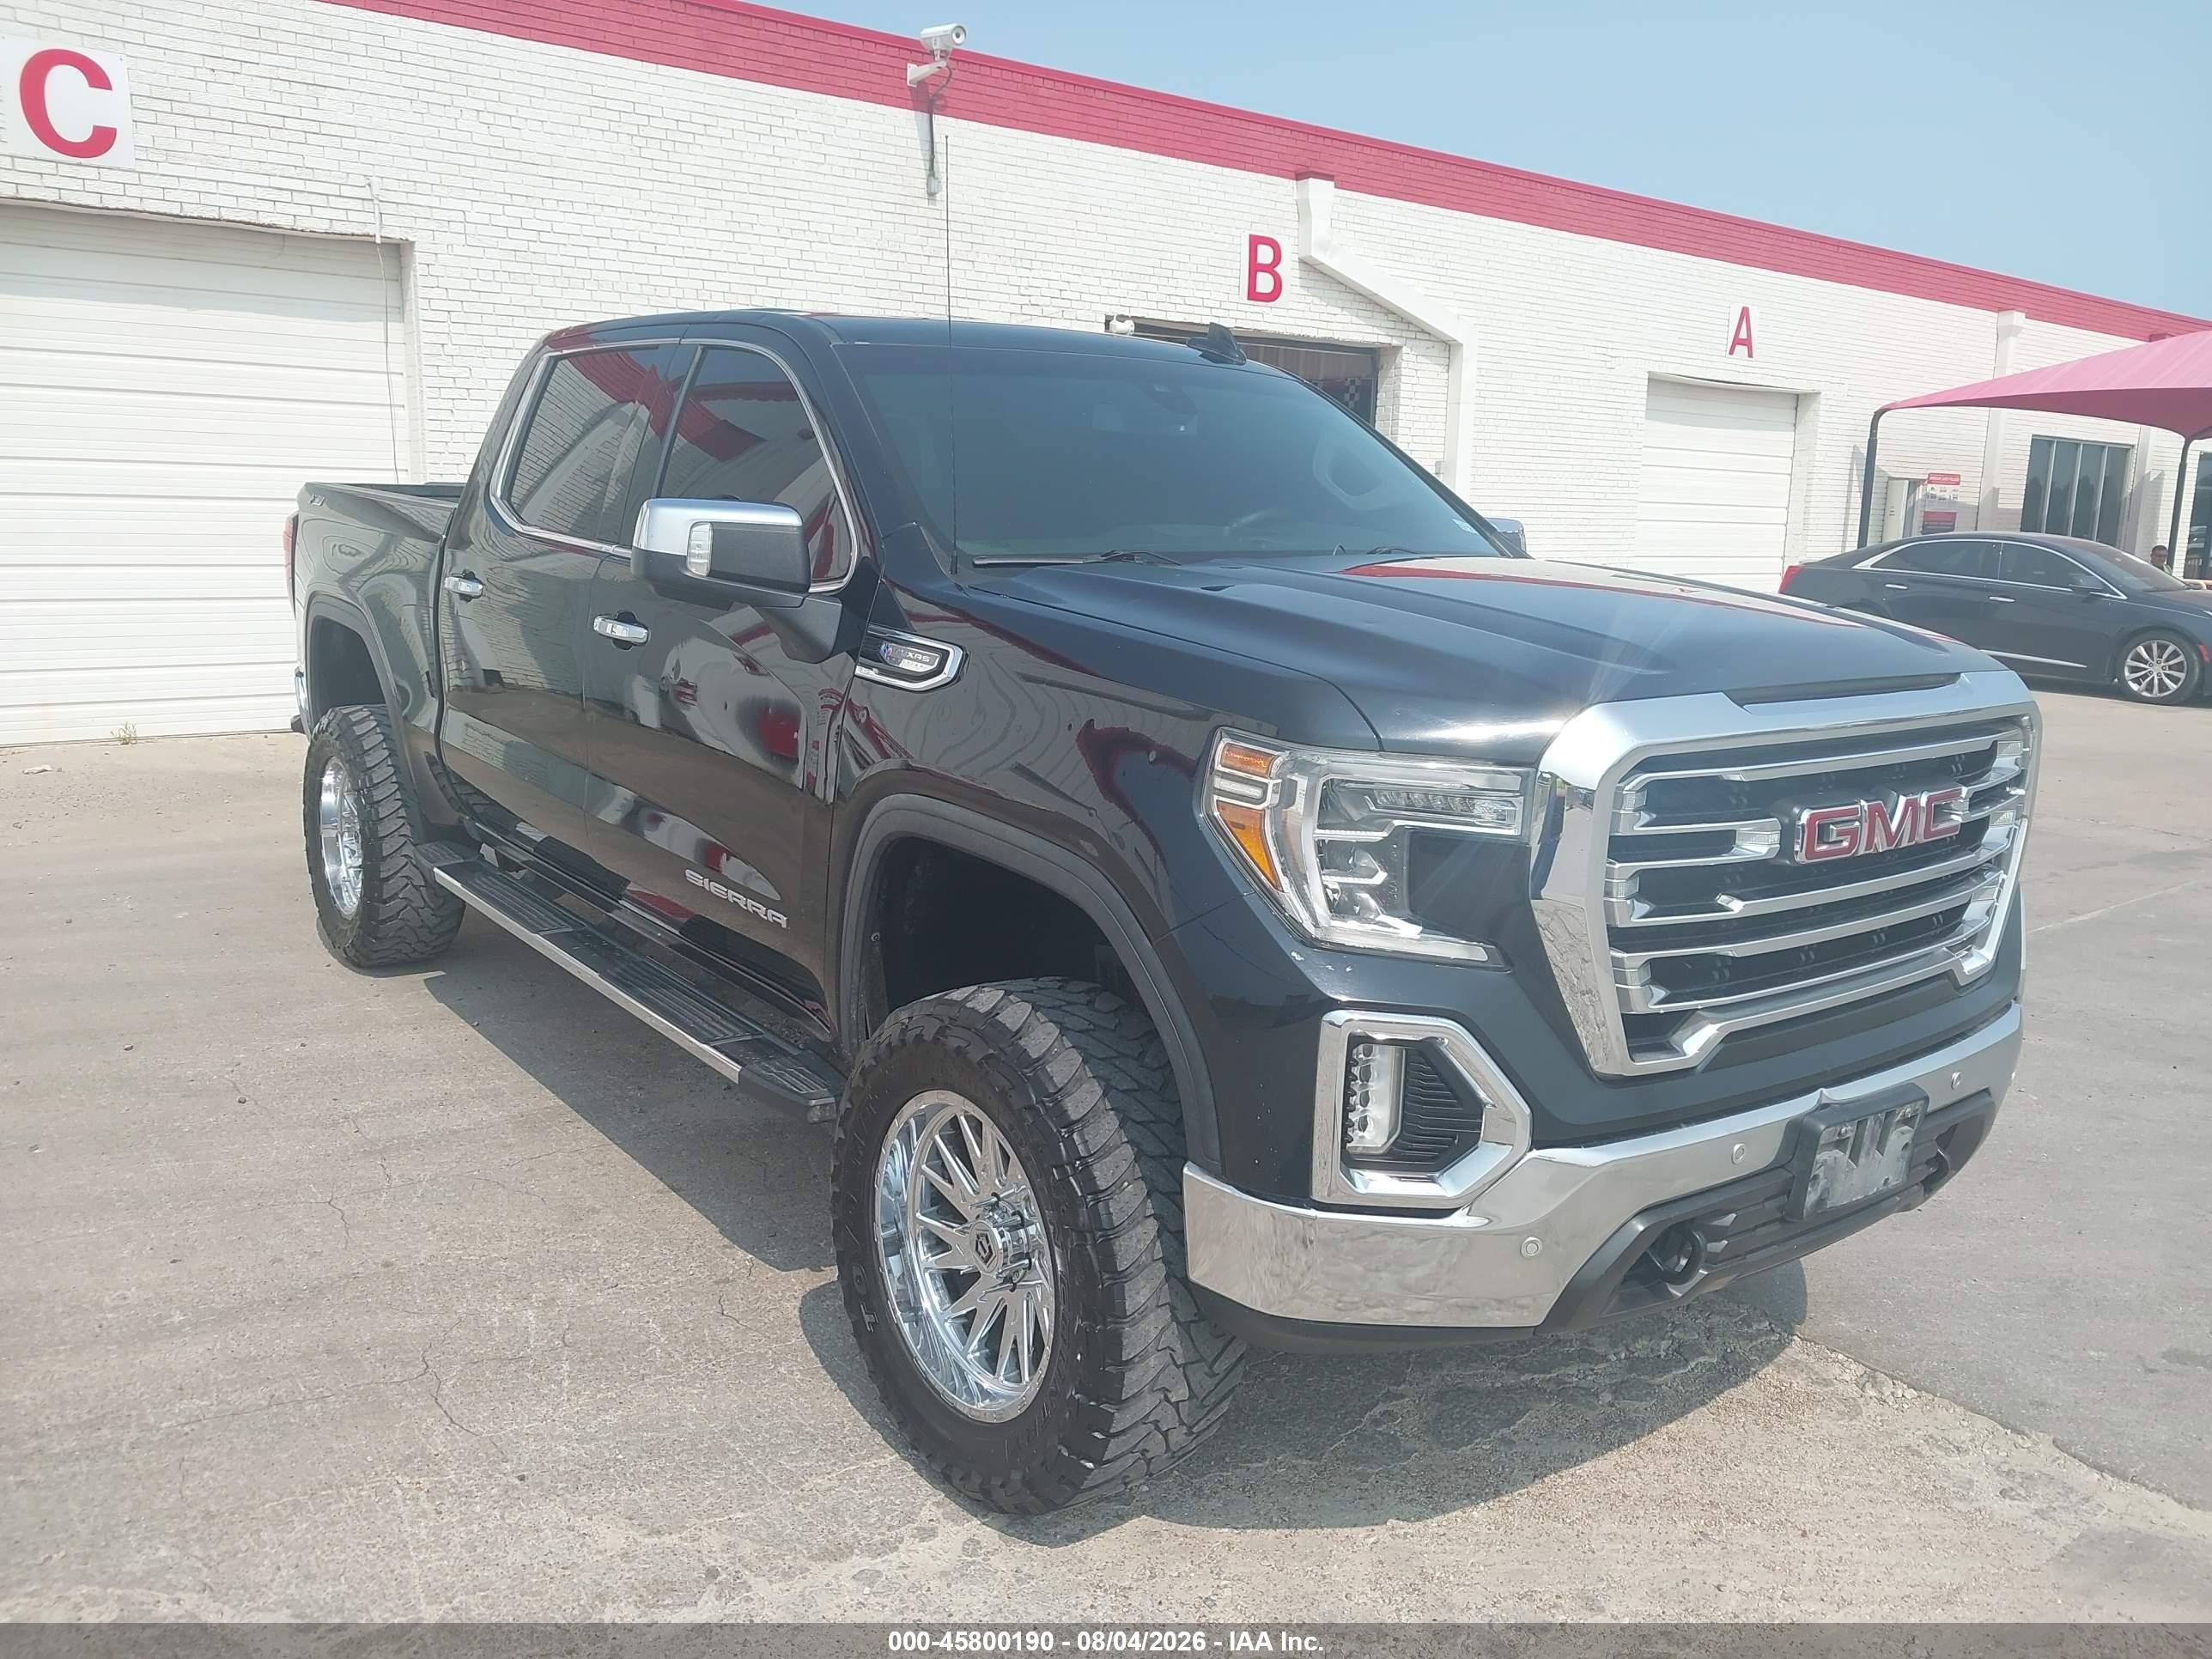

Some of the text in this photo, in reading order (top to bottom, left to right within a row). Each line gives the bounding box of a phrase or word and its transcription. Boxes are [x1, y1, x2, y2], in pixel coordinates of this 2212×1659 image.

[19, 48, 118, 159] C
[1247, 234, 1283, 303] B
[1729, 306, 1753, 358] A
[1795, 787, 1966, 865] GMC
[684, 868, 788, 928] SIERRA
